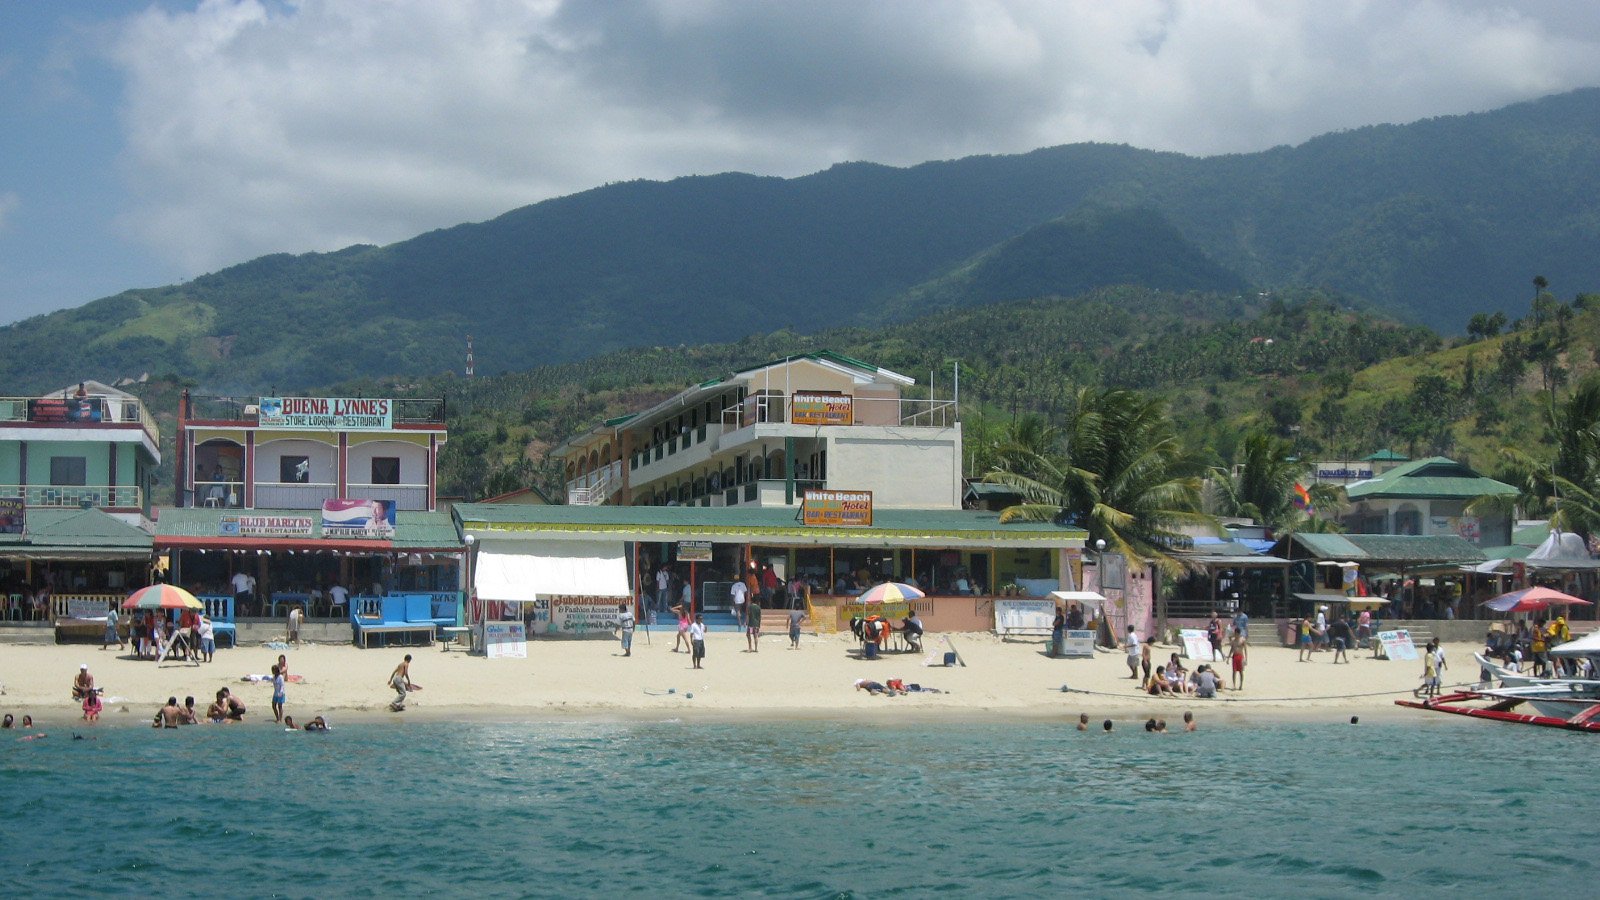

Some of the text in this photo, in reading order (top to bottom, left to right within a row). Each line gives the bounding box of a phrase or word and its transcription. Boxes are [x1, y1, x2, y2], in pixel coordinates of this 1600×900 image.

[794, 395, 850, 404] White Beach
[282, 399, 388, 416] BUENA LYNNE'S
[826, 403, 850, 411] Hotel
[309, 416, 337, 427] LODGING
[343, 416, 386, 427] RESTAURANT
[805, 491, 870, 501] White Beach
[842, 501, 868, 510] Hotel
[824, 511, 868, 519] RESTAURANT
[240, 517, 266, 527] BLUE
[565, 606, 590, 614] Fashion
